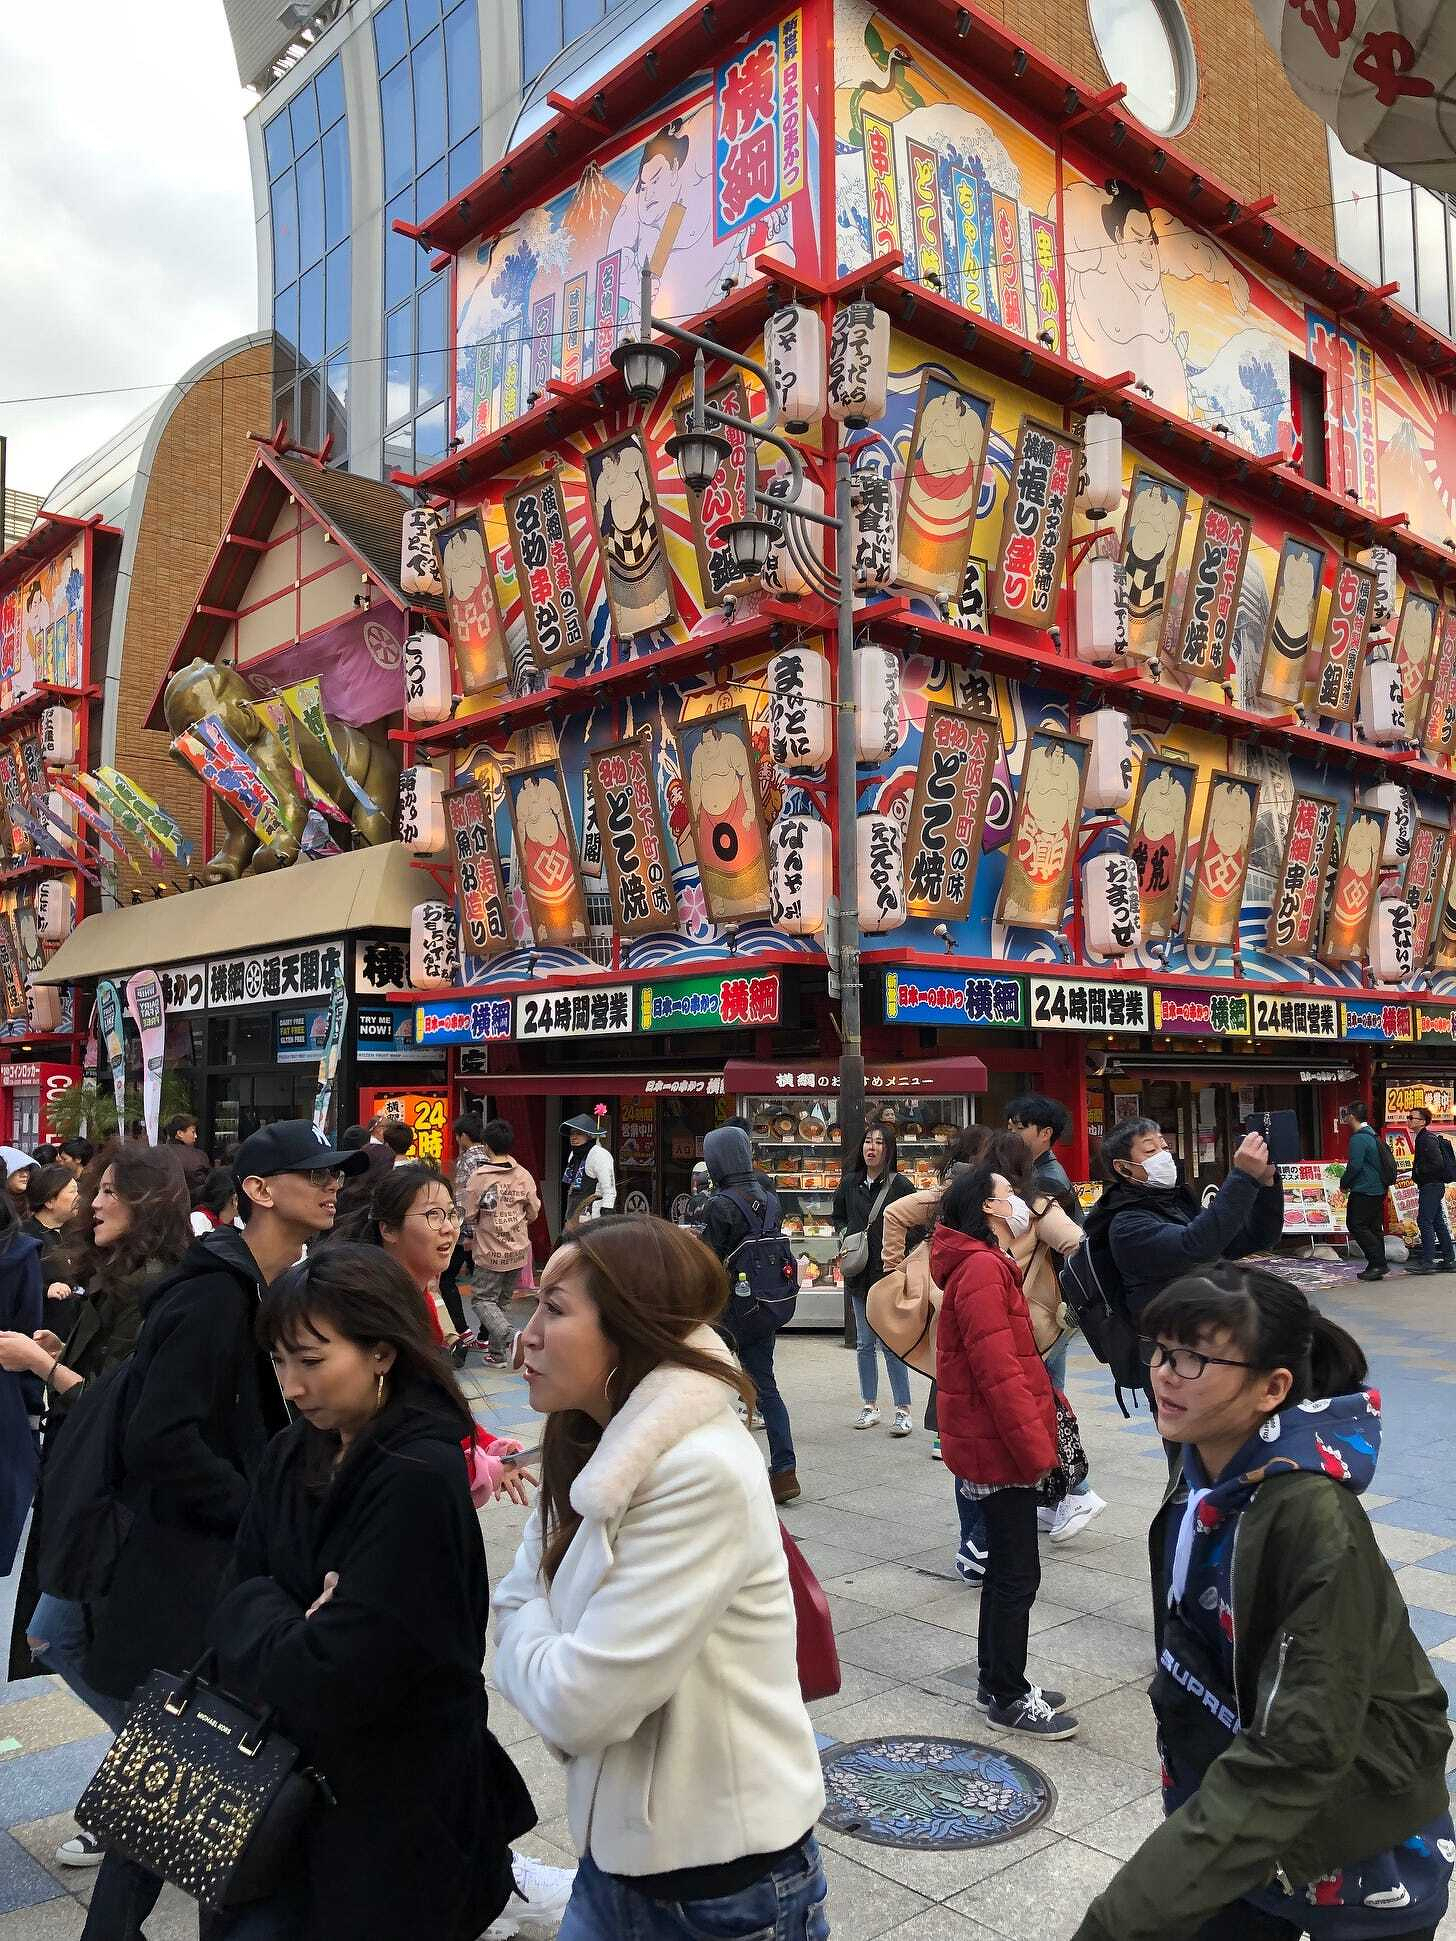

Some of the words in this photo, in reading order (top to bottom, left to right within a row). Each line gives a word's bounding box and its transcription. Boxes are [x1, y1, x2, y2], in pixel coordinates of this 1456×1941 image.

[719, 41, 777, 223] 横綱
[956, 177, 983, 315] ちゃんこ
[1034, 226, 1060, 353] 串かつ
[515, 496, 562, 654] 名物串かつ
[1210, 521, 1244, 669] 大阪下町の味
[1182, 541, 1227, 667] どて焼
[1318, 567, 1360, 709] もつ鍋
[934, 716, 970, 752] 名物
[628, 751, 671, 914] 大阪下町の味
[908, 750, 968, 905] どて焼
[945, 727, 989, 904] 大阪下町の味
[606, 786, 650, 923] どて焼
[211, 960, 244, 1003] 横綱
[262, 947, 341, 997] 通天閣店
[652, 994, 719, 1018] 日本一の串かつ
[720, 975, 779, 1024] 横綱
[359, 1015, 376, 1024] TRY
[379, 1015, 391, 1024] ME
[471, 999, 512, 1038] 横綱
[524, 992, 629, 1034] 24時間営業
[898, 984, 964, 1008] 日本一の串かつ
[964, 978, 1022, 1022] 横綱
[1035, 985, 1145, 1025] 24時間営業
[1209, 995, 1249, 1031] 横綱
[1257, 1000, 1334, 1035] 24時間営業
[1380, 1006, 1412, 1037] 横綱
[359, 1024, 391, 1036] NOW!
[645, 1079, 704, 1093] 日本一の串かつ
[196, 1711, 218, 1728] MICHAEL
[217, 1721, 232, 1735] KORS
